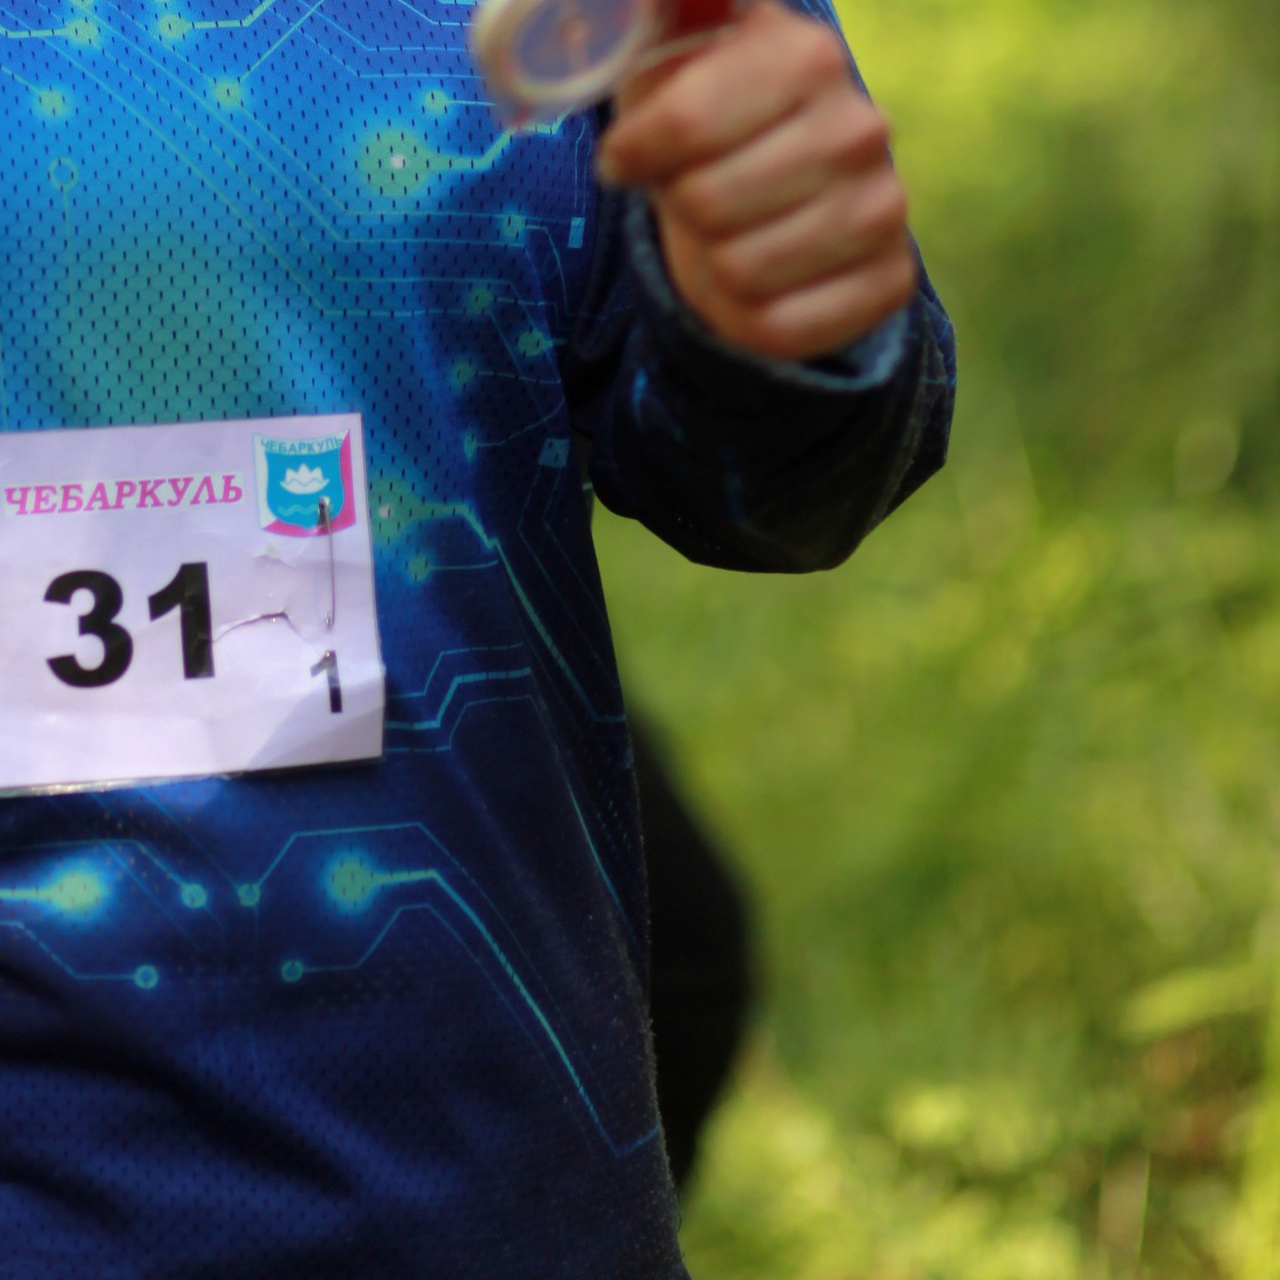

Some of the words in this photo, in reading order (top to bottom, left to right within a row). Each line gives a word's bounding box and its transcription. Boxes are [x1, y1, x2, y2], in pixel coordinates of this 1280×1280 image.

[260, 435, 343, 455] ЧЕБАРКУЛЬ
[4, 474, 243, 516] ЧЕБАРКУЛЬ
[42, 560, 216, 689] 31
[310, 649, 344, 714] 1
